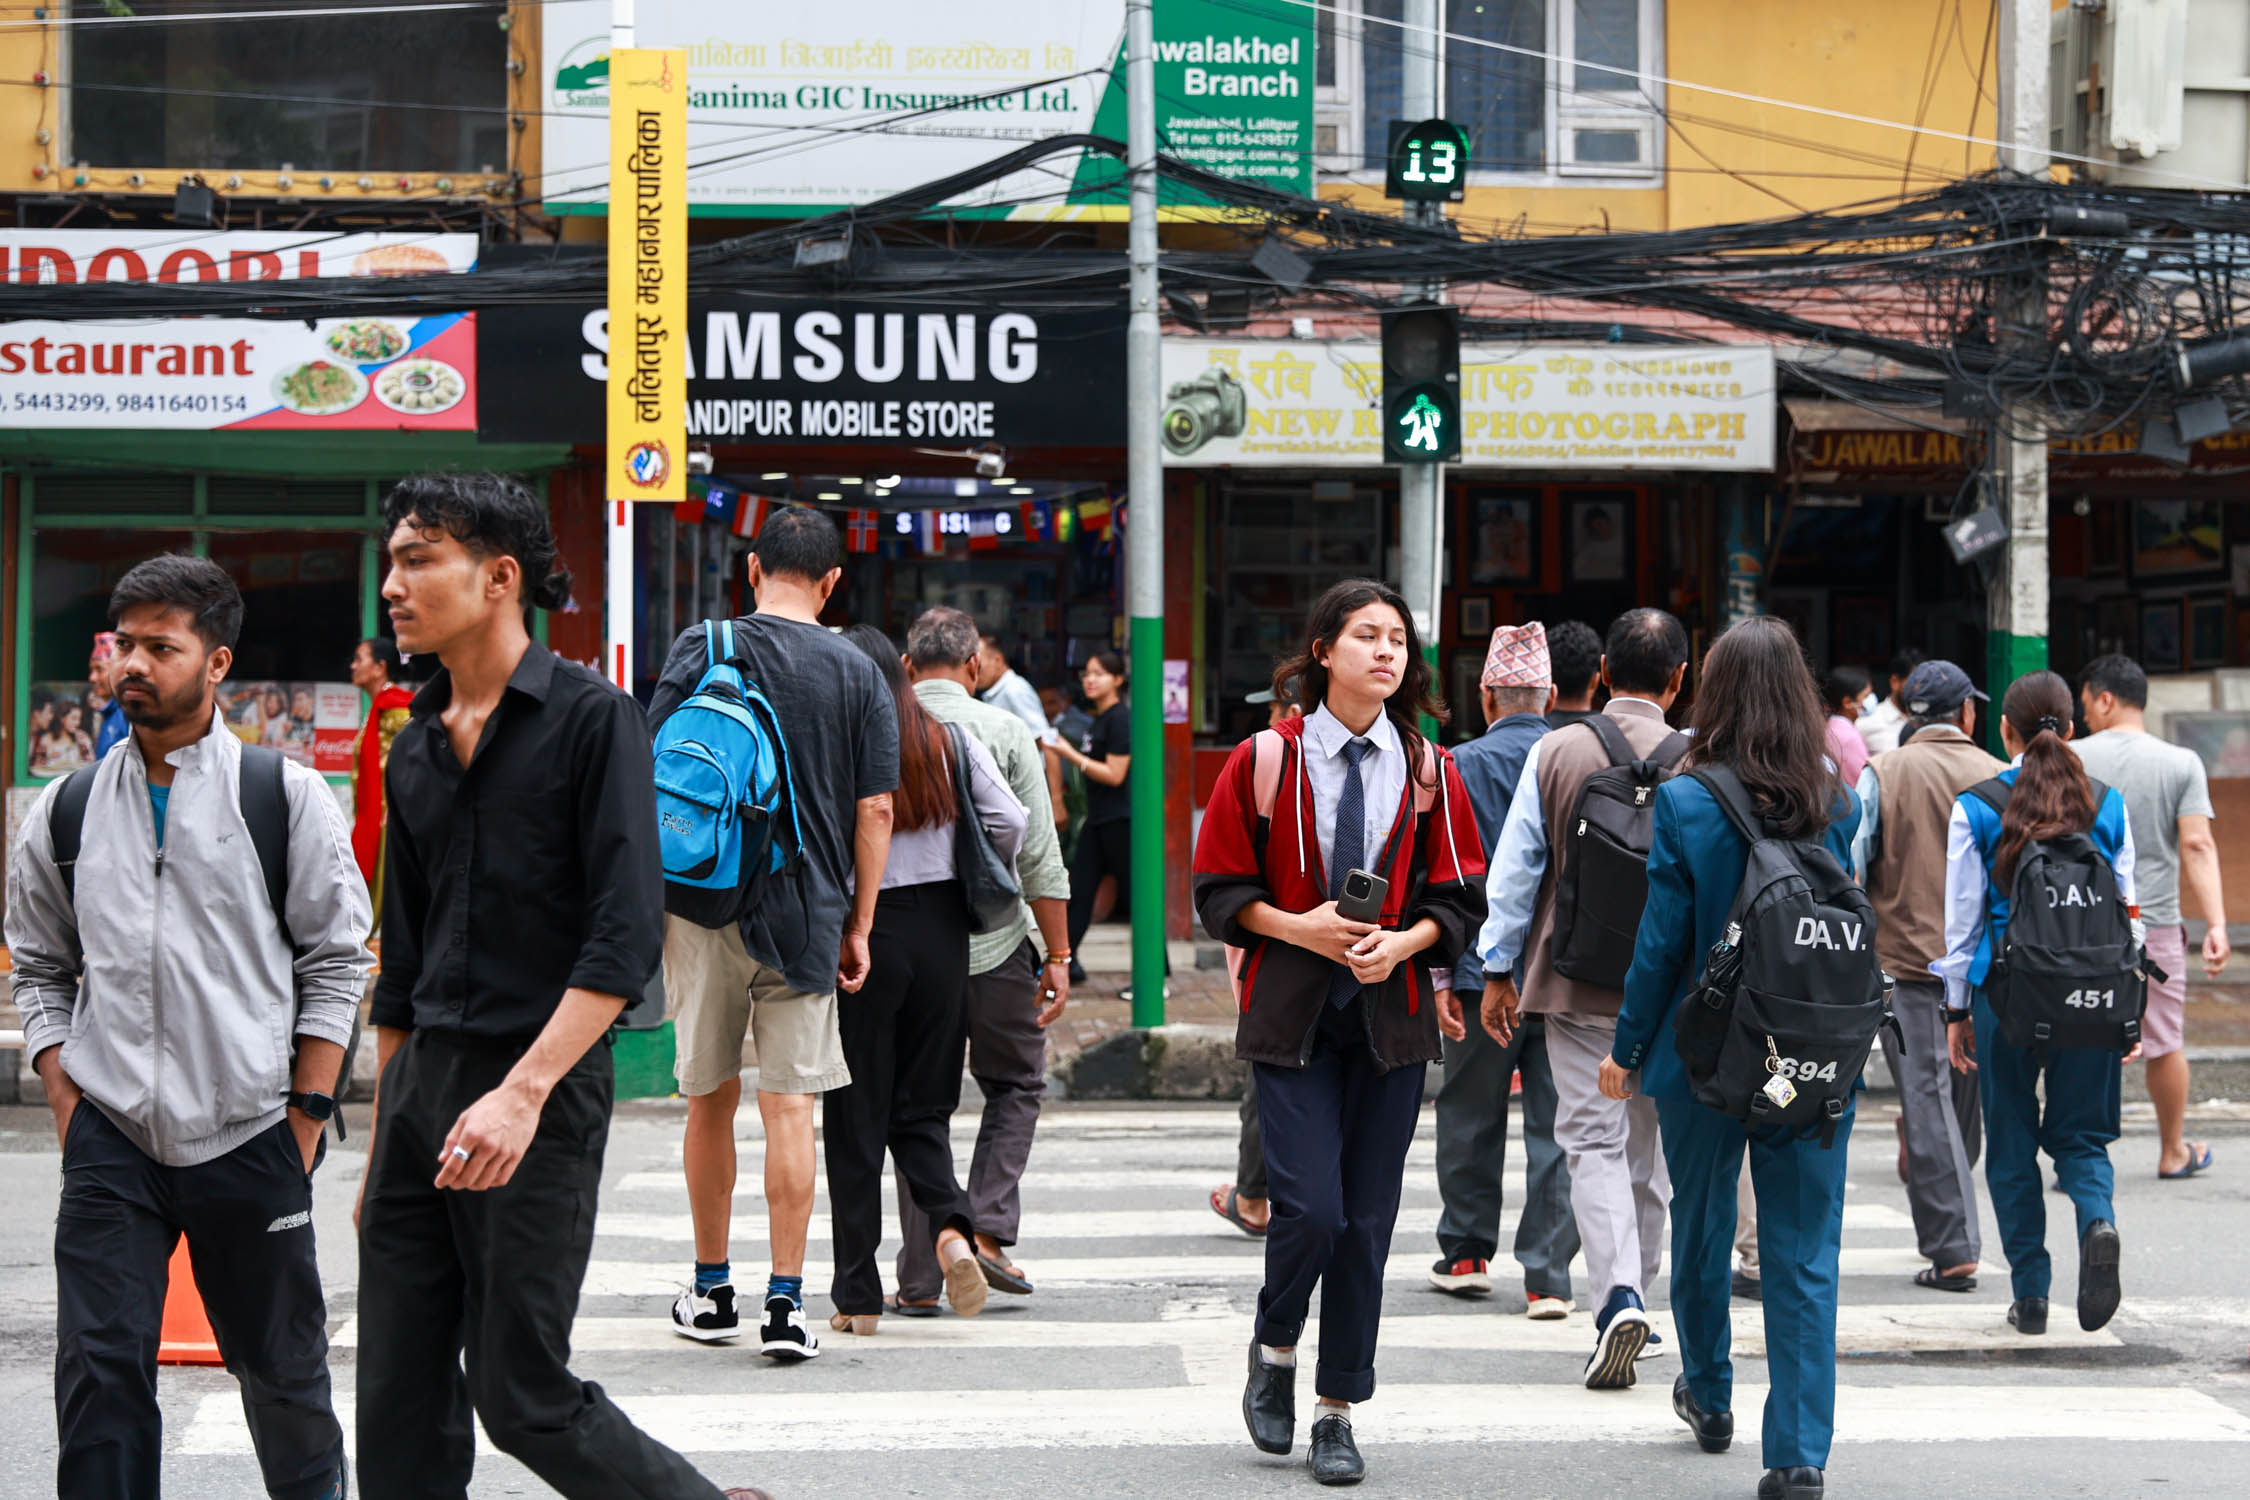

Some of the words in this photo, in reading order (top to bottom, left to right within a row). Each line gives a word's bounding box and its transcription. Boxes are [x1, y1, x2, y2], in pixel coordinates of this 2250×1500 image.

[1122, 35, 1299, 65] walakhel
[1184, 67, 1299, 98] Branch
[686, 85, 788, 109] anima
[796, 86, 854, 110] GIC
[862, 87, 1012, 113] Insurance
[1022, 87, 1079, 113] Ltd.
[1168, 130, 1189, 145] Tel
[1402, 139, 1457, 184] 13
[627, 109, 664, 305] महानगरपालिका
[581, 309, 1039, 384] SMSUNG
[627, 314, 668, 423] ललितपुर
[1249, 350, 1316, 400] रवि
[14, 392, 110, 413] 5443299,
[116, 393, 247, 413] 9841640154
[801, 400, 901, 437] MOBILE
[906, 401, 995, 437] STORE
[1247, 409, 1341, 437] NEW
[1463, 411, 1748, 440] PHOTOGRAPH
[2065, 989, 2115, 1009] 451
[1779, 1057, 1837, 1083] 694
